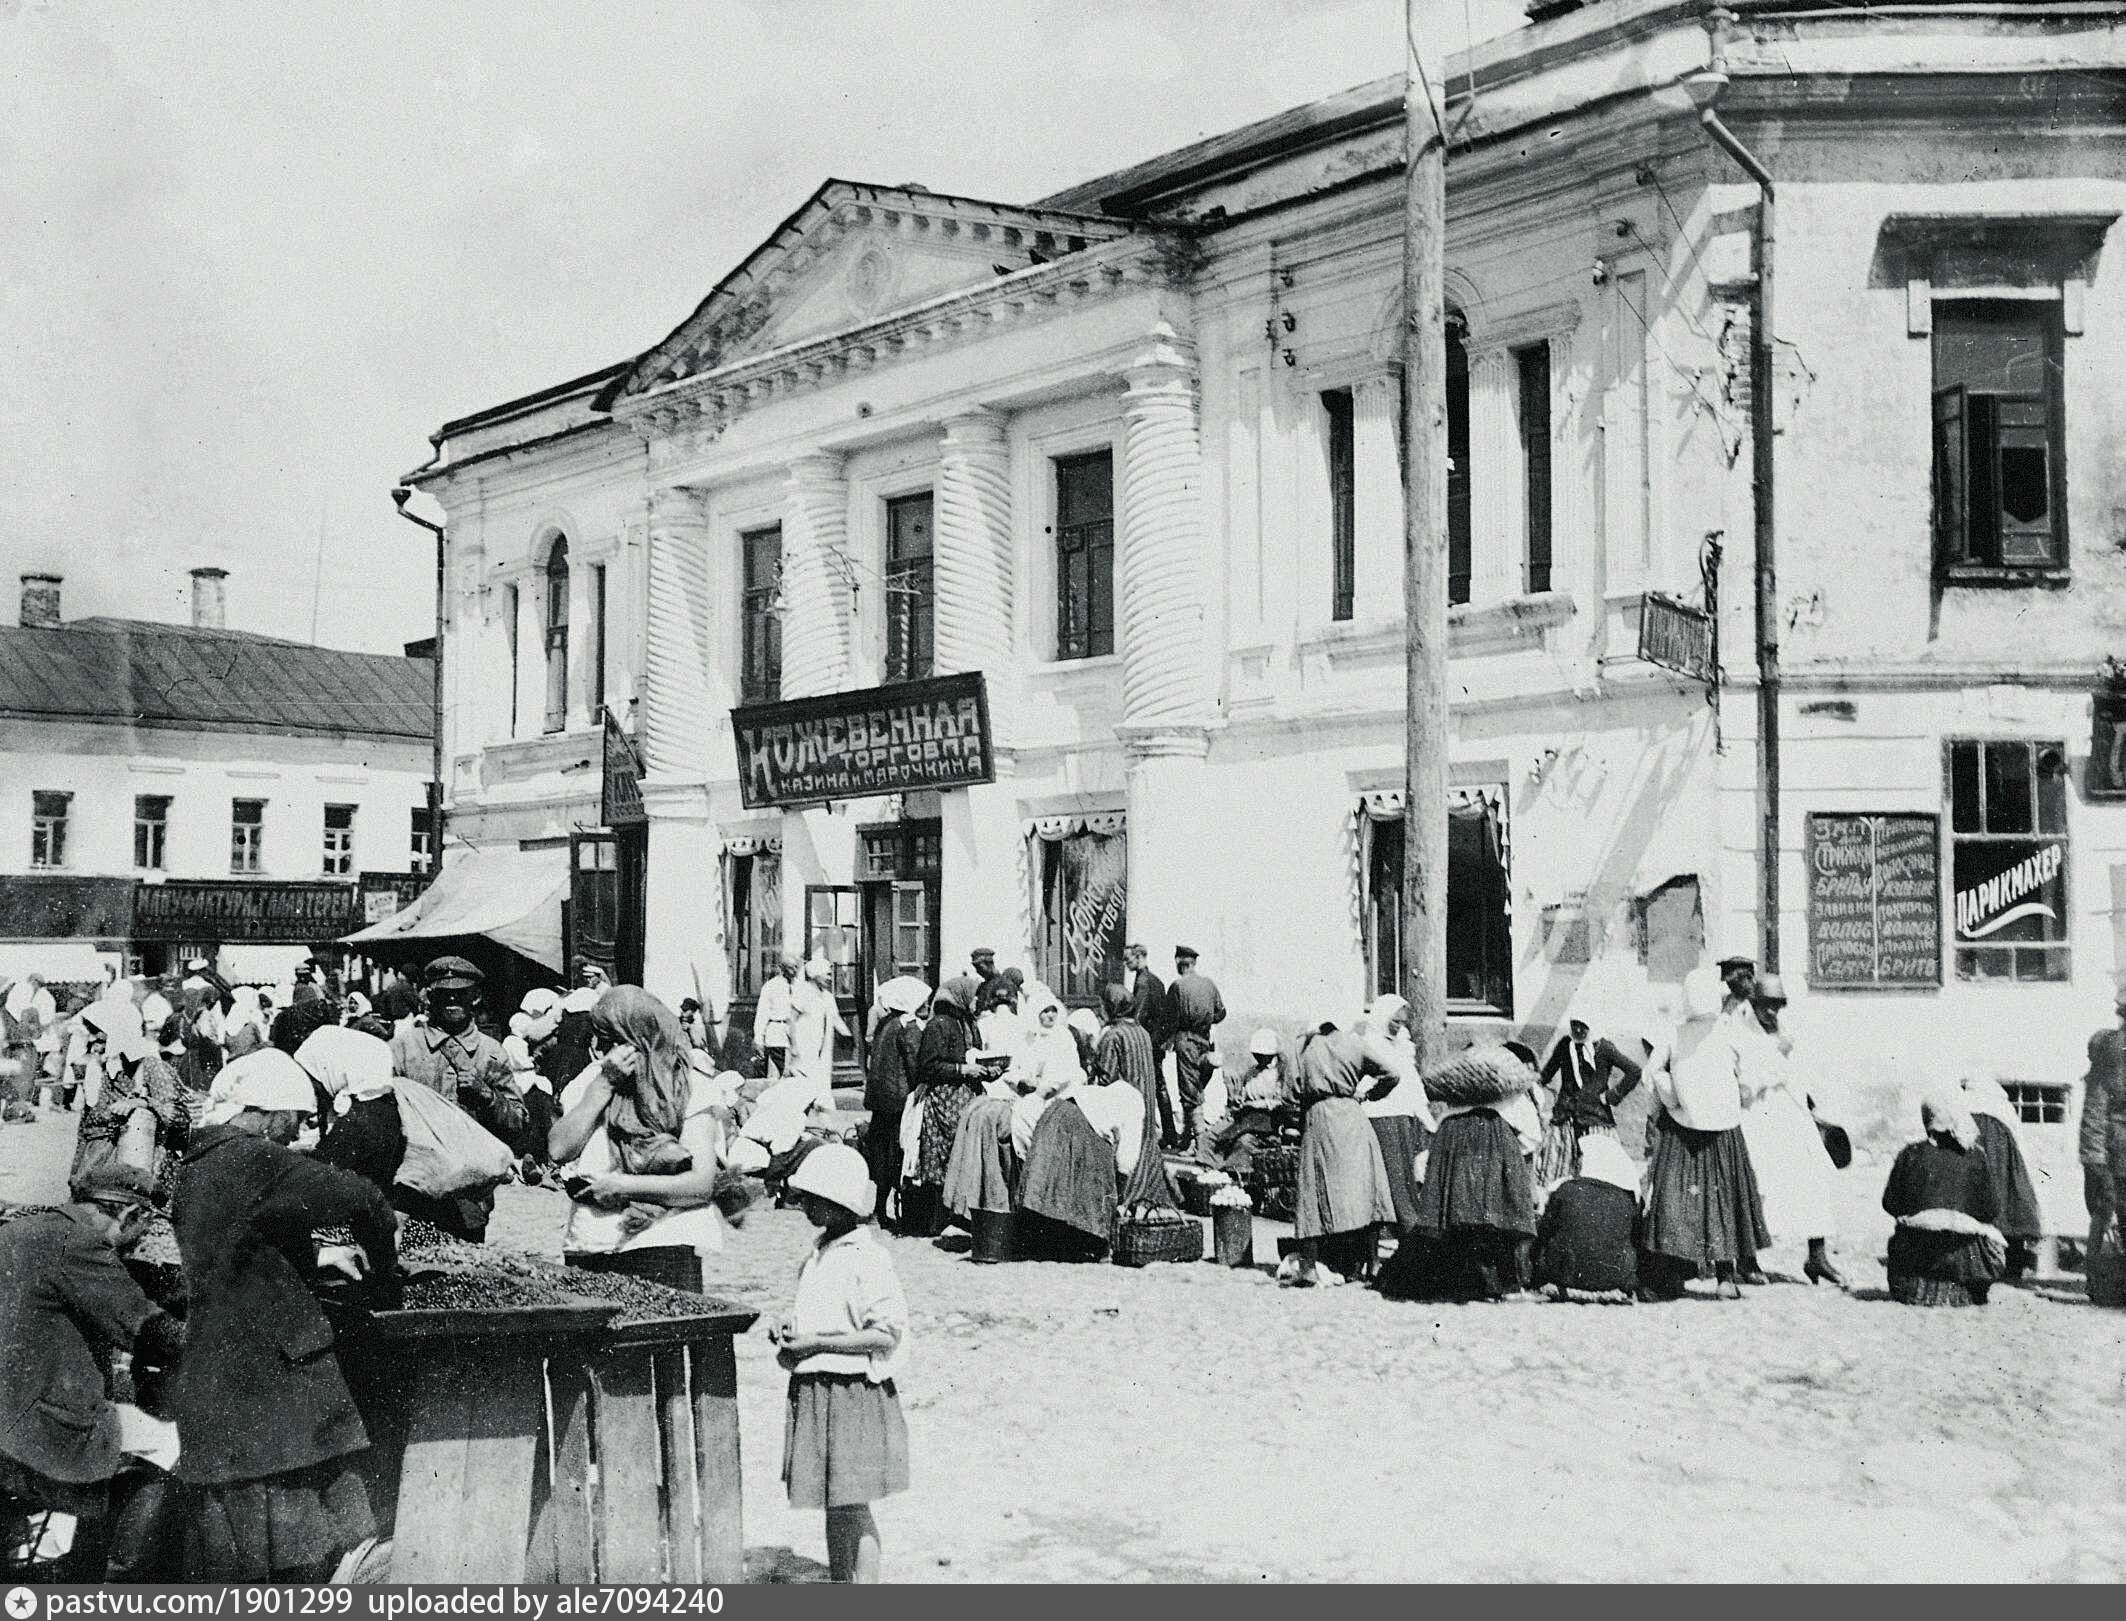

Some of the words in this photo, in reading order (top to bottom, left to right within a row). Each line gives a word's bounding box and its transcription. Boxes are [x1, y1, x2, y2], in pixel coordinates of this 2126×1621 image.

[742, 697, 980, 801] КОЖЕВЕННАЯ
[839, 735, 981, 770] ТОРГОВЛЯ
[781, 771, 849, 793] КАЗИНА
[1956, 843, 2062, 933] ПАРИКМАХЕР
